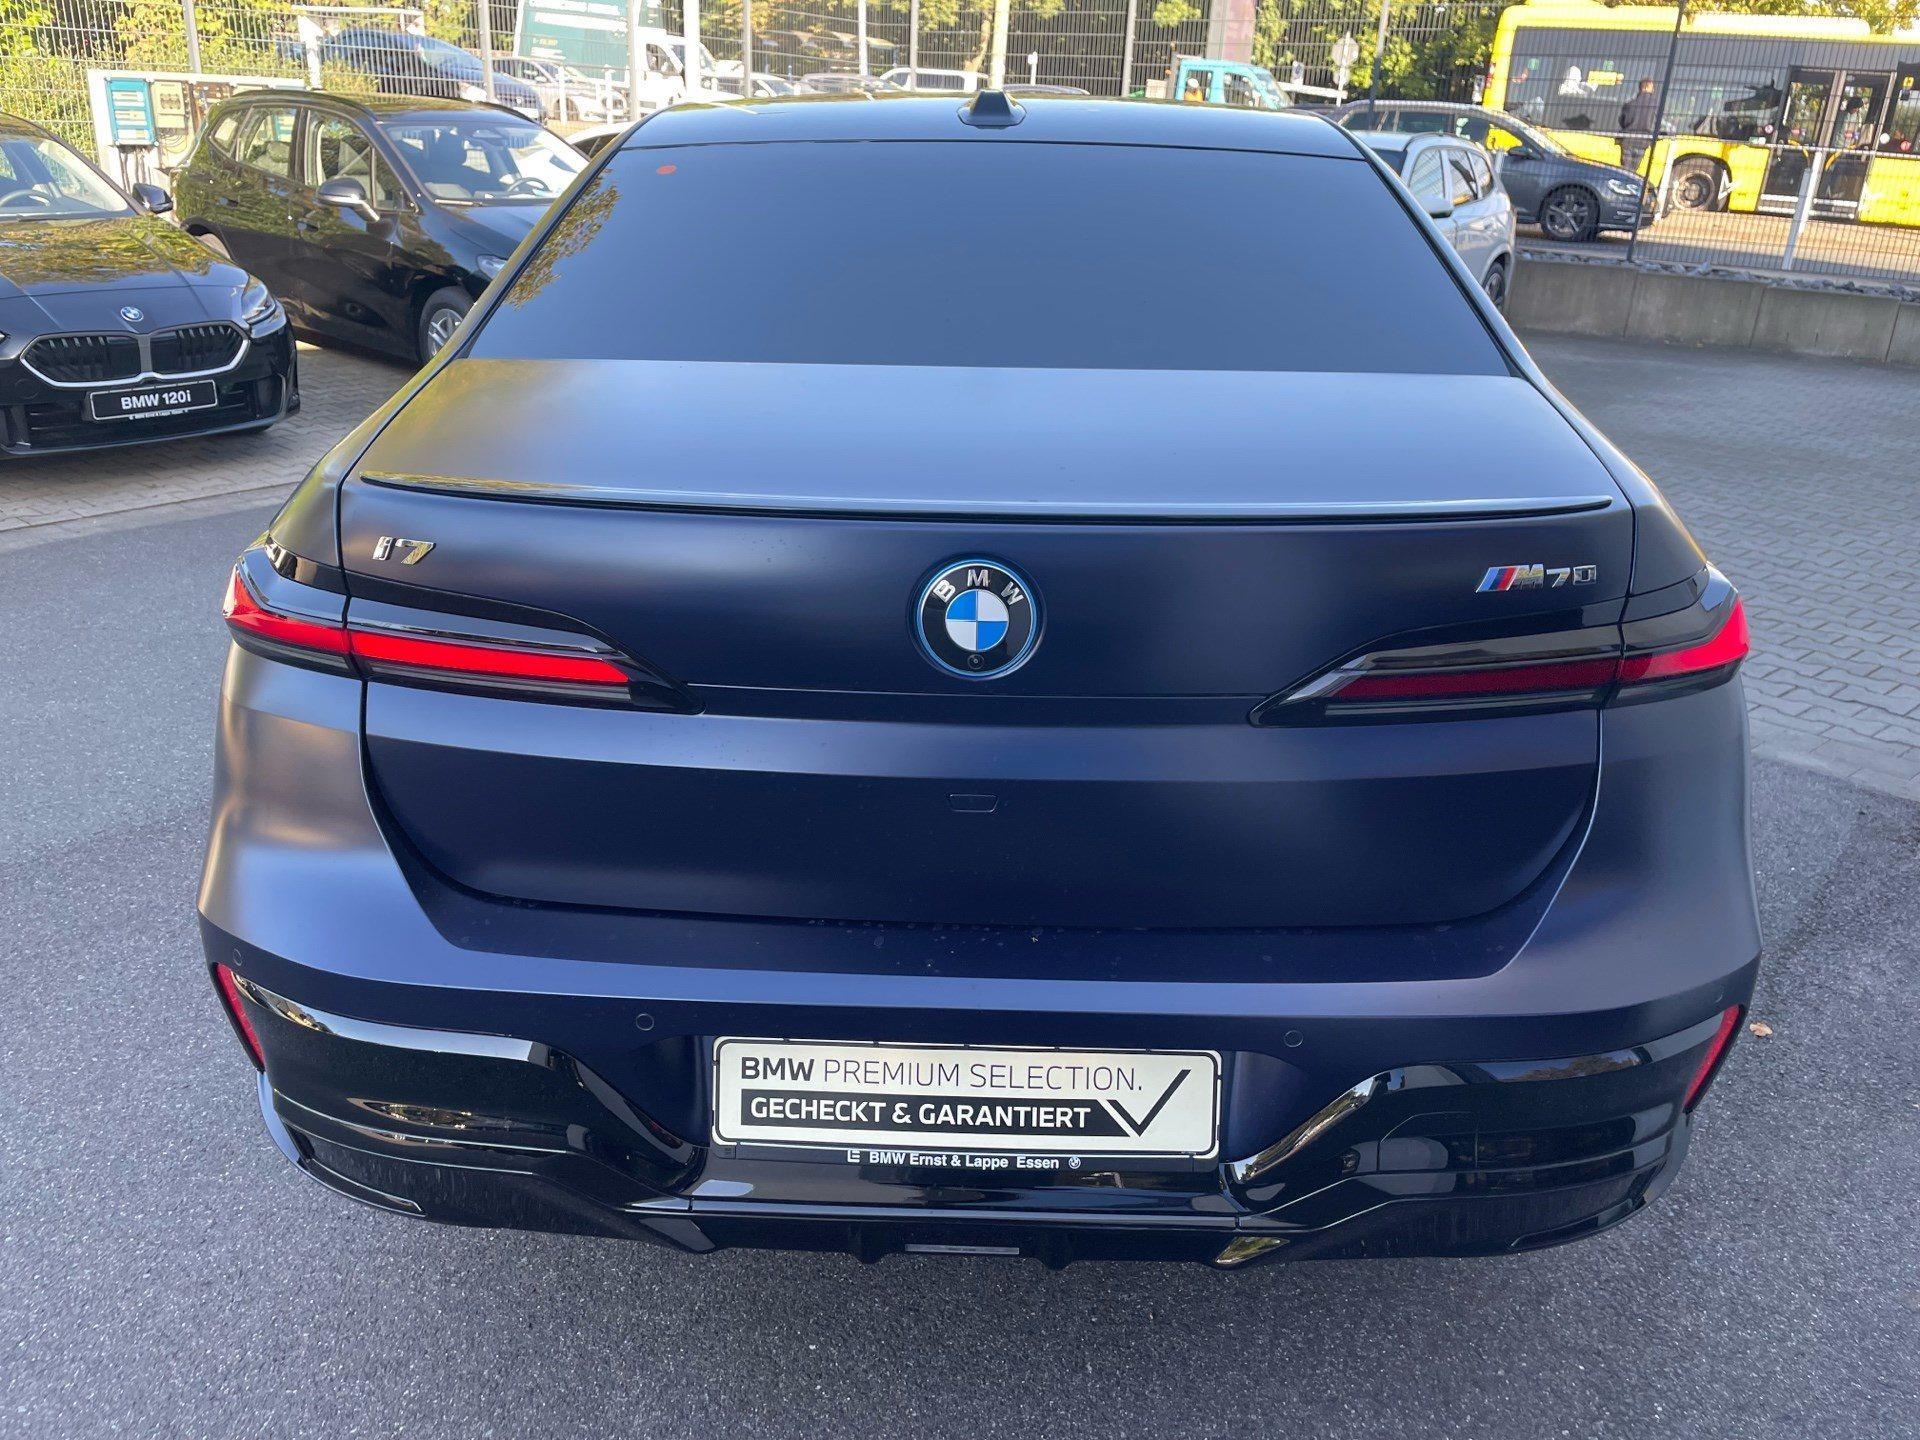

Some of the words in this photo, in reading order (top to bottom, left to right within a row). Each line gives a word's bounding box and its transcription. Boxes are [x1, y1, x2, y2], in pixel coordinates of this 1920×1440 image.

[121, 394, 159, 410] BMW
[162, 389, 192, 405] 120i
[372, 536, 435, 566] i7
[932, 568, 1025, 606] BMW
[741, 1056, 815, 1082] BMW
[824, 1059, 960, 1087] PREMIUM
[969, 1063, 1142, 1091] SELECTION.
[750, 1096, 887, 1123] GECHECKT
[891, 1102, 912, 1125] &
[918, 1103, 1092, 1129] GARANTIERT
[869, 1151, 906, 1165] BMW
[909, 1152, 948, 1167] Ernst
[950, 1154, 962, 1167] &
[965, 1154, 1009, 1171] Lappe
[1016, 1155, 1060, 1169] Essen
